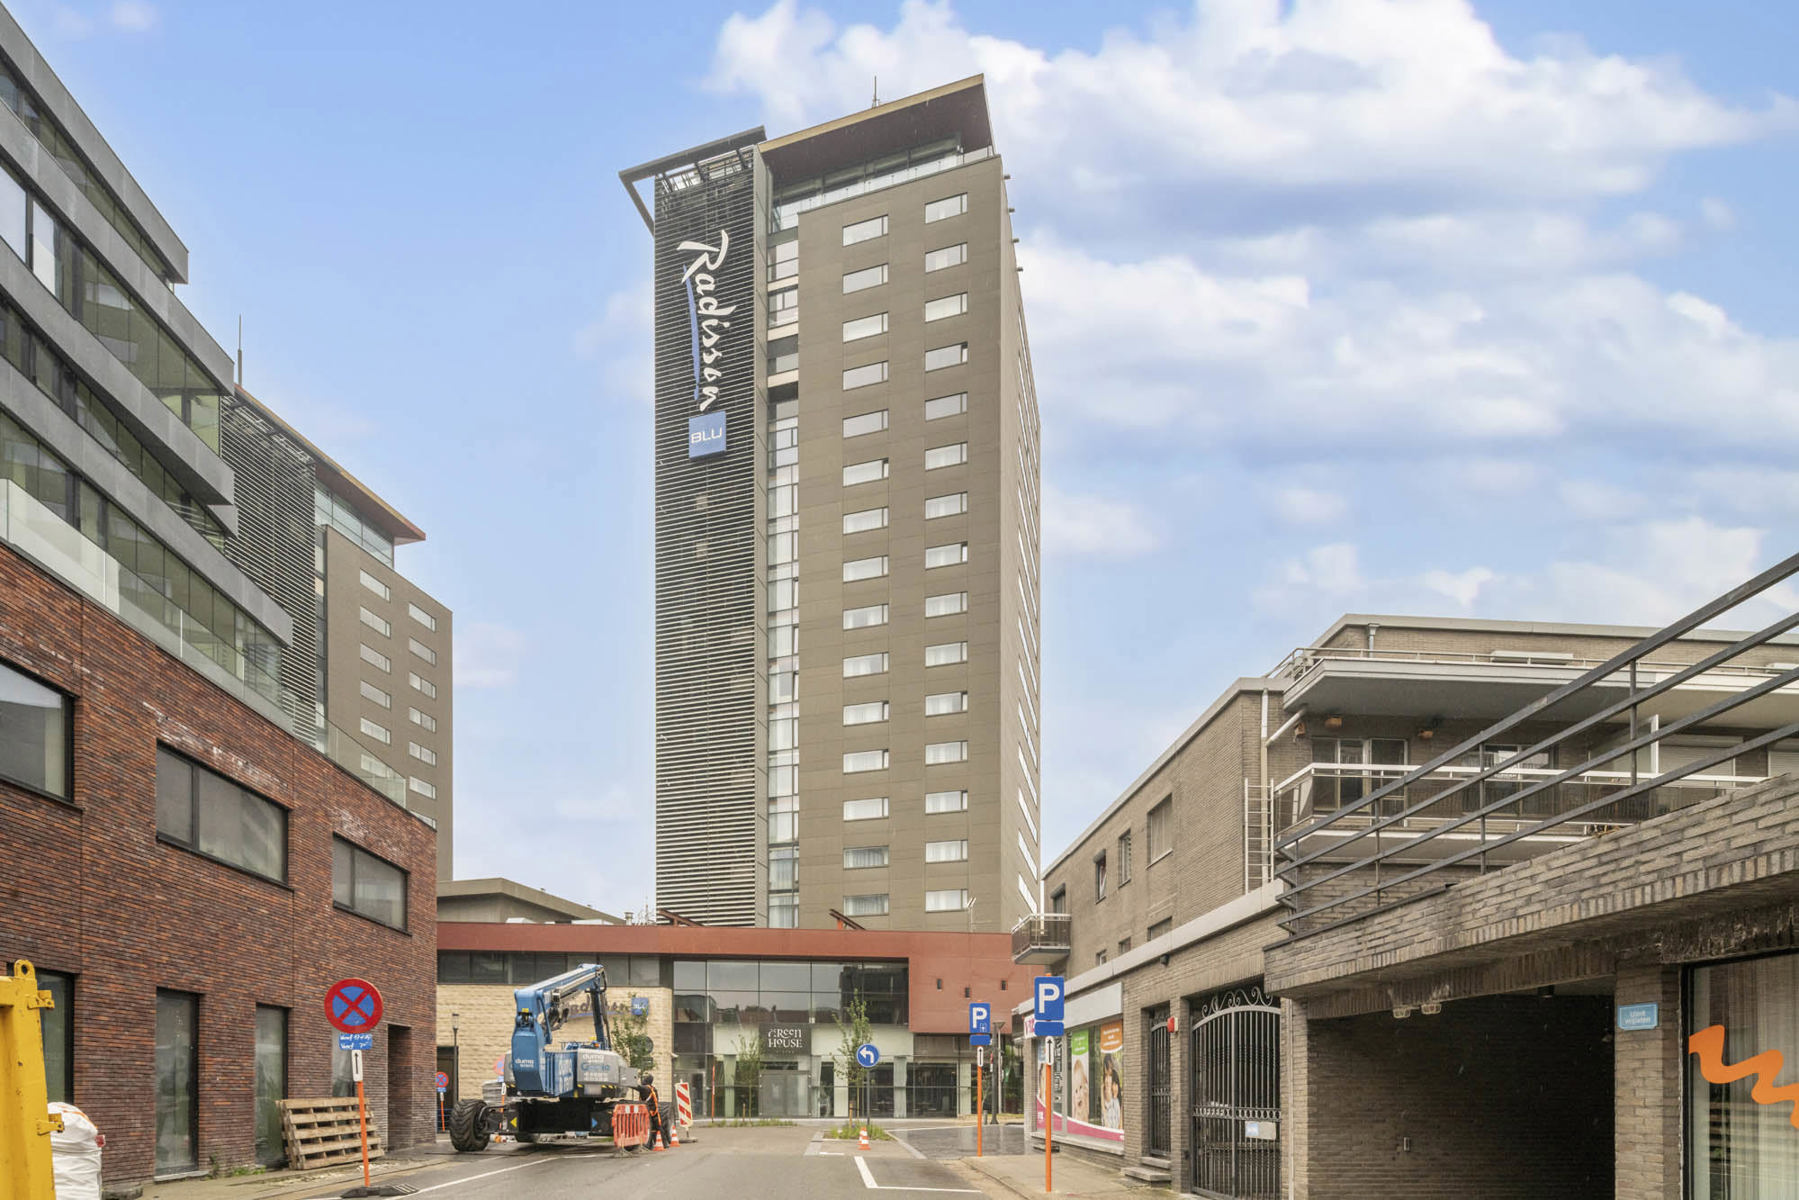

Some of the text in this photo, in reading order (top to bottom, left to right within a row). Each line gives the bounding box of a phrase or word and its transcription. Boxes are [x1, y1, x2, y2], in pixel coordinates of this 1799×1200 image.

[676, 229, 737, 411] Radisson
[691, 426, 722, 443] BLU
[1038, 983, 1060, 1013] P
[972, 1007, 988, 1029] P
